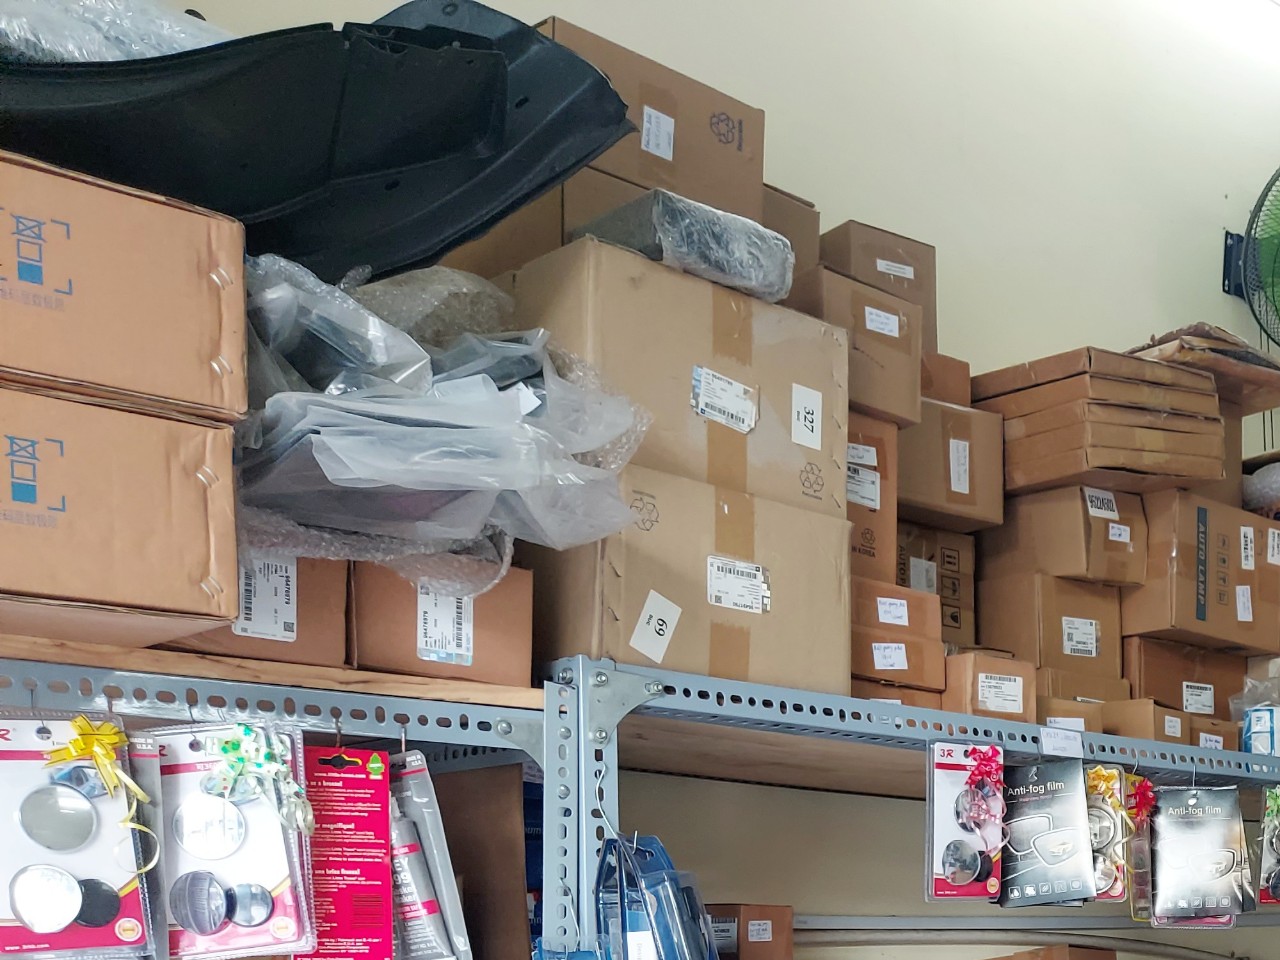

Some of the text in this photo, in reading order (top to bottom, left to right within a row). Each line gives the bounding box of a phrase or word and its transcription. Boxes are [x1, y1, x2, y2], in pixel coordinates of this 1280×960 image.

[803, 407, 815, 433] 327
[940, 748, 954, 759] 3R
[1007, 780, 1065, 797] Anti-fog film
[1168, 804, 1223, 817] Anti-fog film
